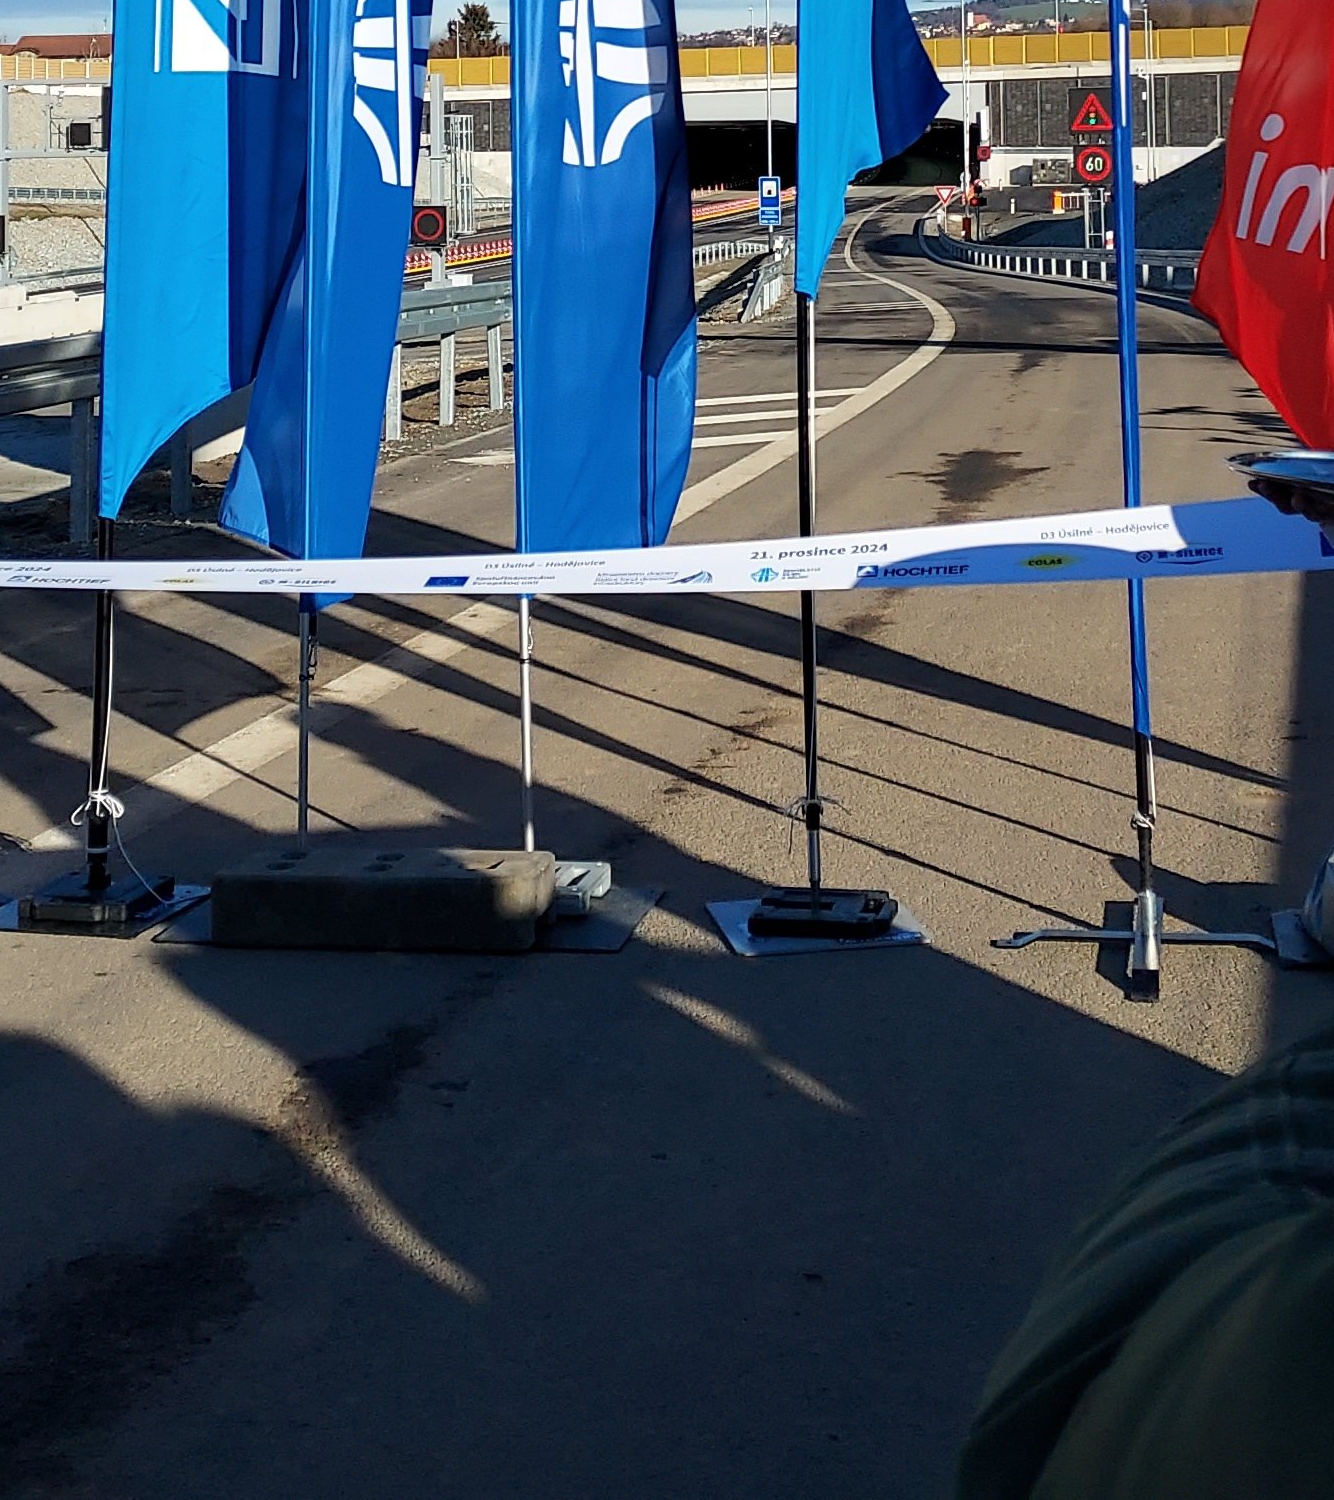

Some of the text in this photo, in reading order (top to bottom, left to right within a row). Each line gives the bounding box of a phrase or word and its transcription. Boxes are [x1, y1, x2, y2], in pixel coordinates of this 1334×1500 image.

[1085, 156, 1103, 172] 60
[1041, 531, 1055, 541] D3
[1058, 527, 1094, 539] Úsilné
[1105, 522, 1170, 536] Hodějovice
[750, 543, 889, 561] 21. prosince 2024
[1028, 557, 1063, 567] COLAS
[883, 564, 970, 578] HOCHTIEF
